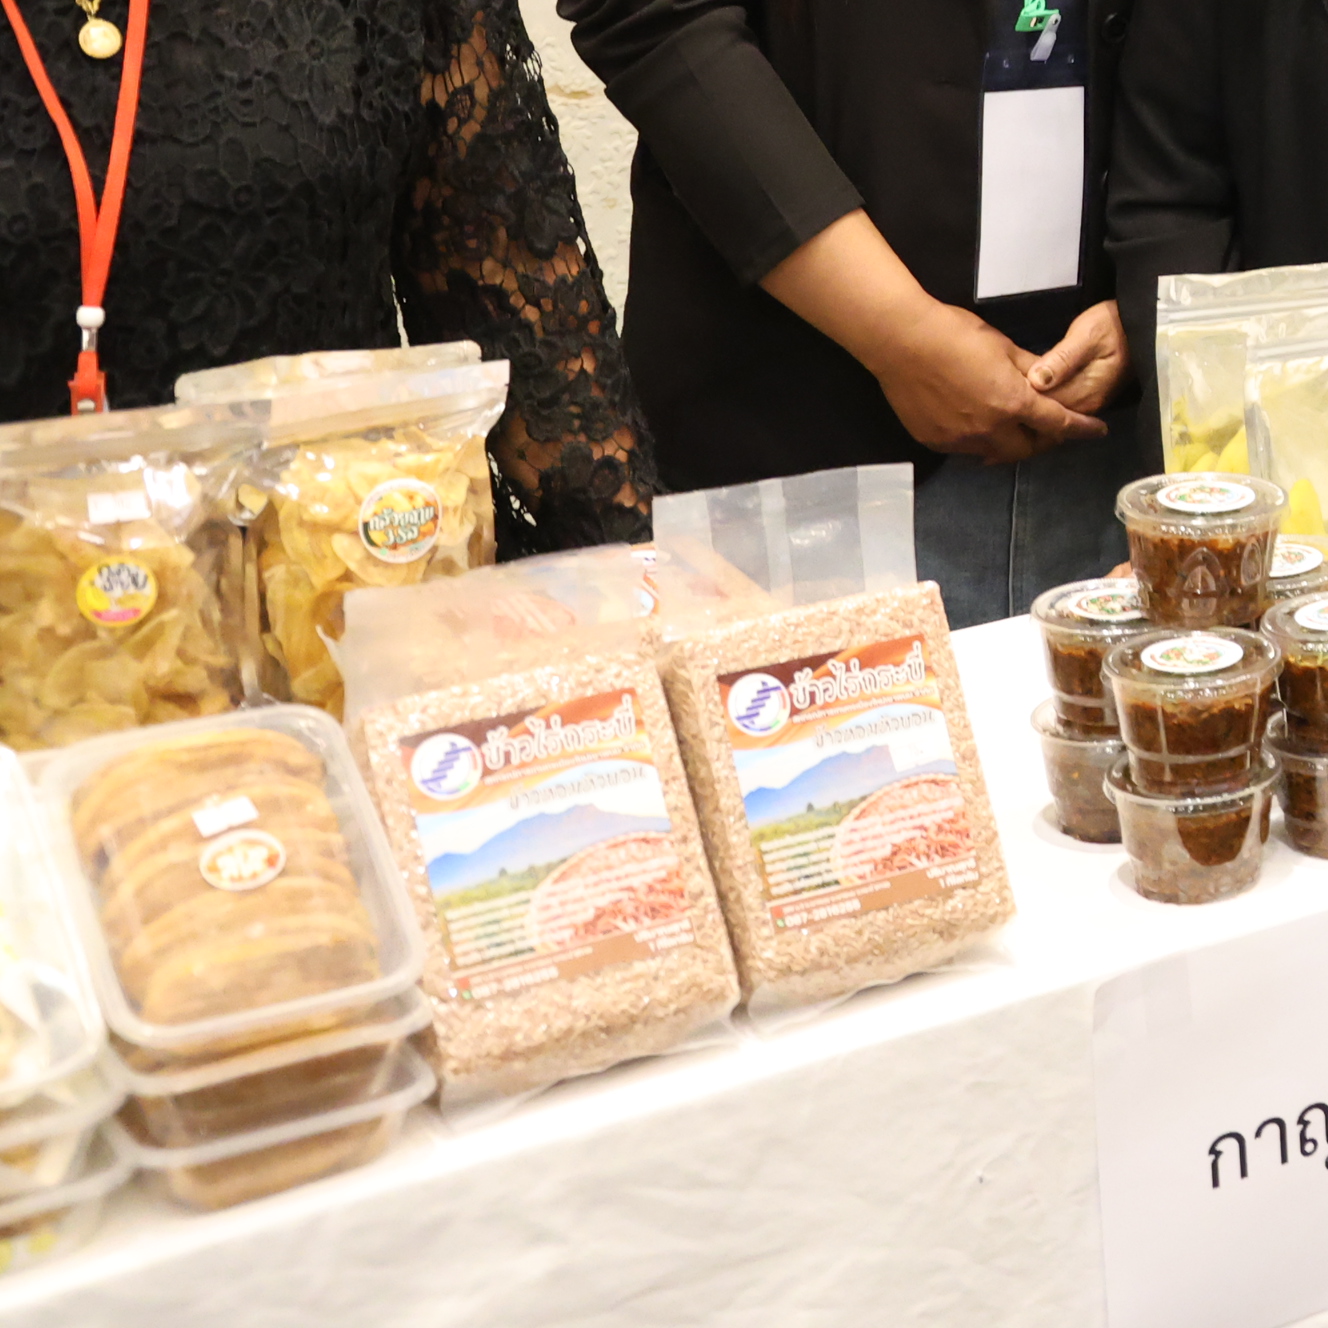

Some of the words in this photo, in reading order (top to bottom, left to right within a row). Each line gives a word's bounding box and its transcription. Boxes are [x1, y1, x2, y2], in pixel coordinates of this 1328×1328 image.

[789, 640, 926, 710] ข้าวไร่กระบี่
[481, 693, 637, 771] ข้าวไร่กระบี่
